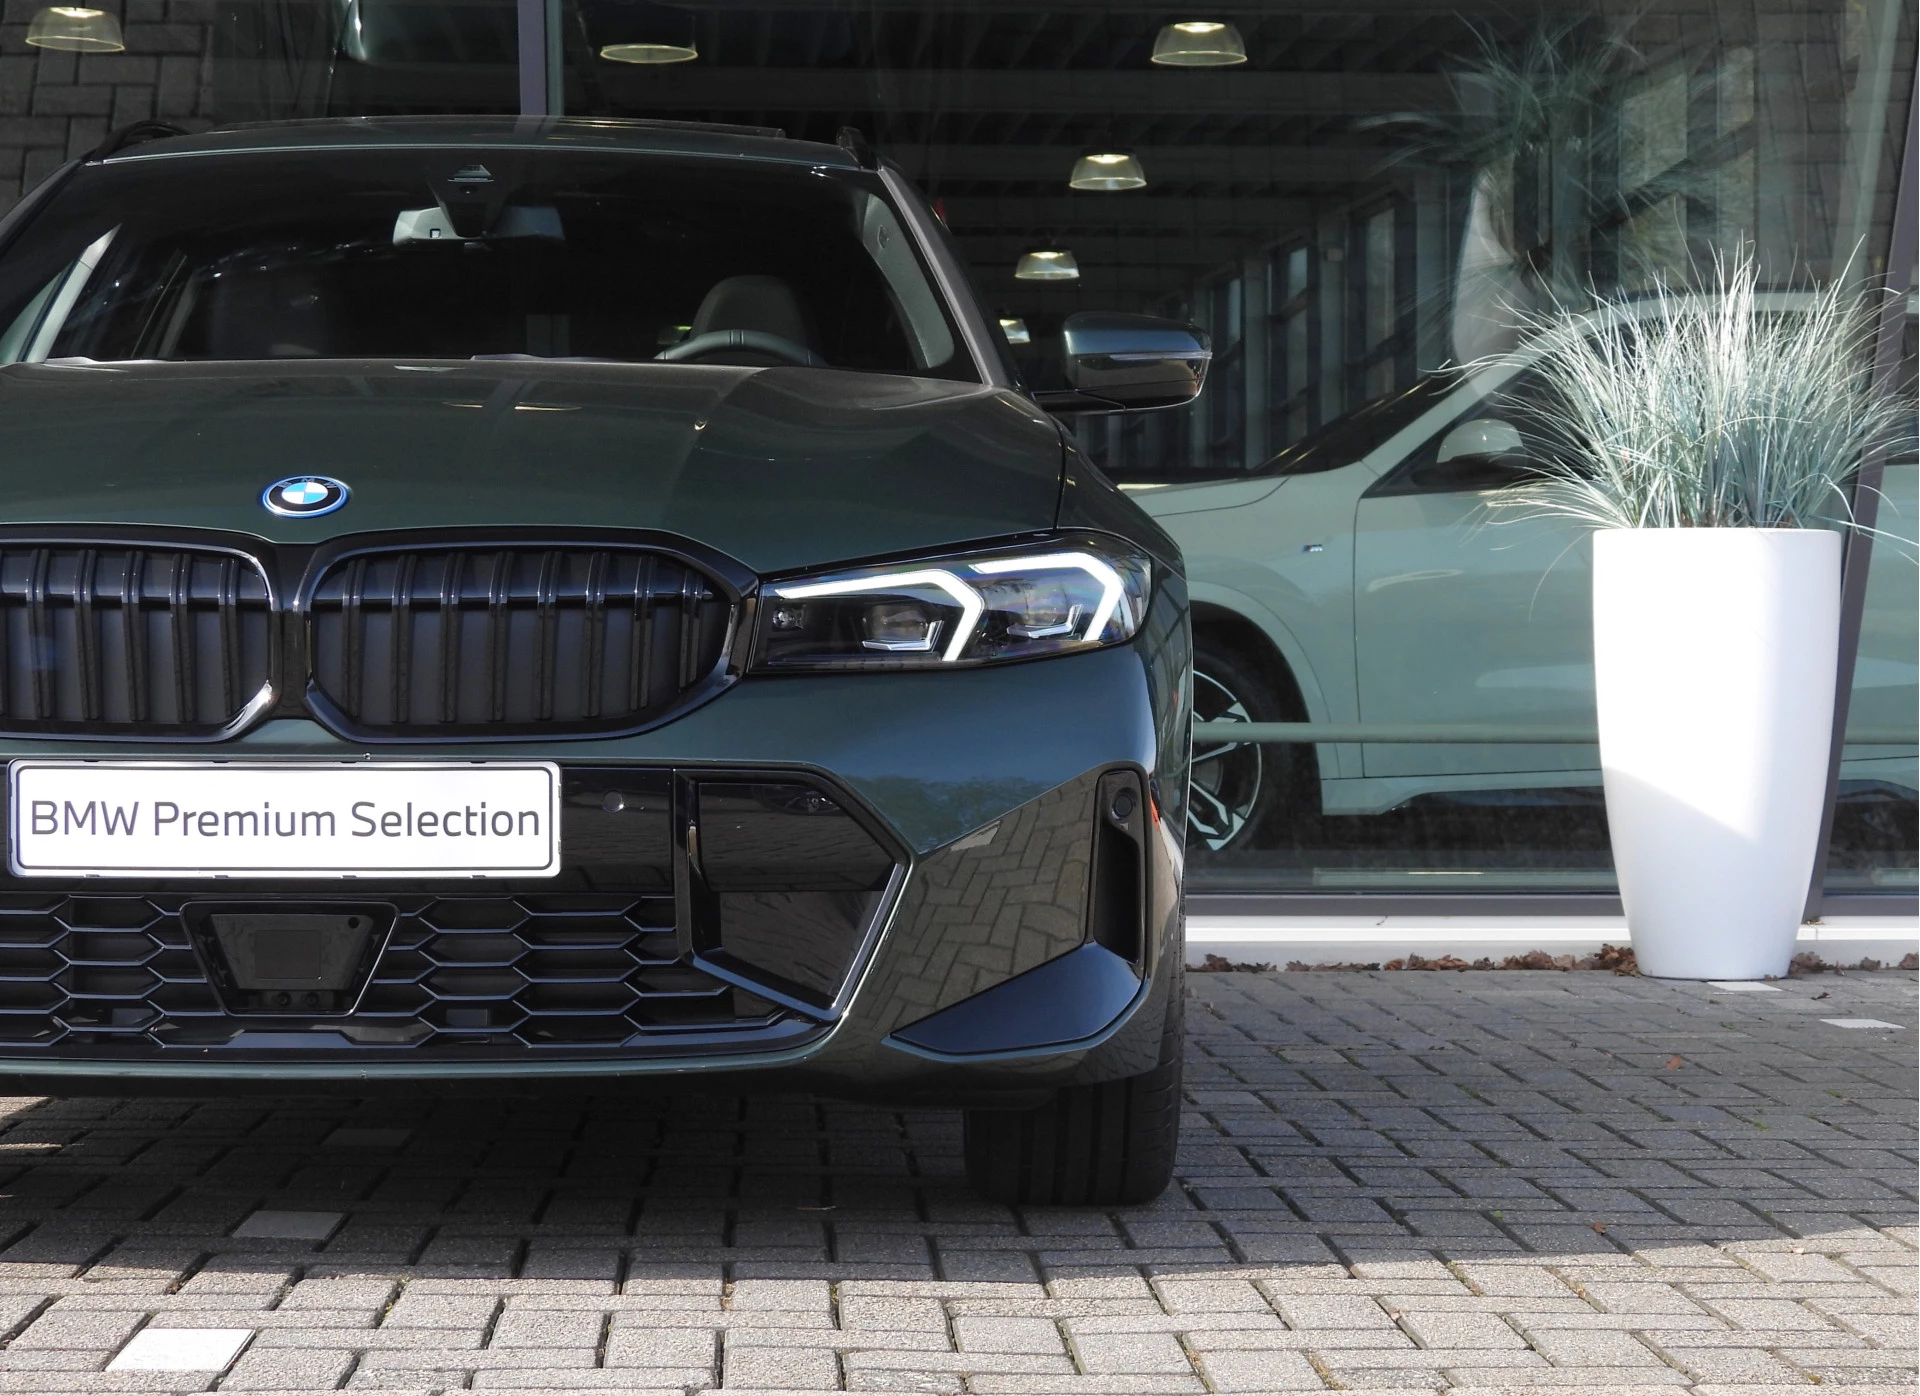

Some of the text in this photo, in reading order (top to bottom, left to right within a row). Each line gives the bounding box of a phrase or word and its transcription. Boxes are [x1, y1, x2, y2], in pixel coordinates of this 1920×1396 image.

[31, 800, 539, 837] BMW Premium Selection
